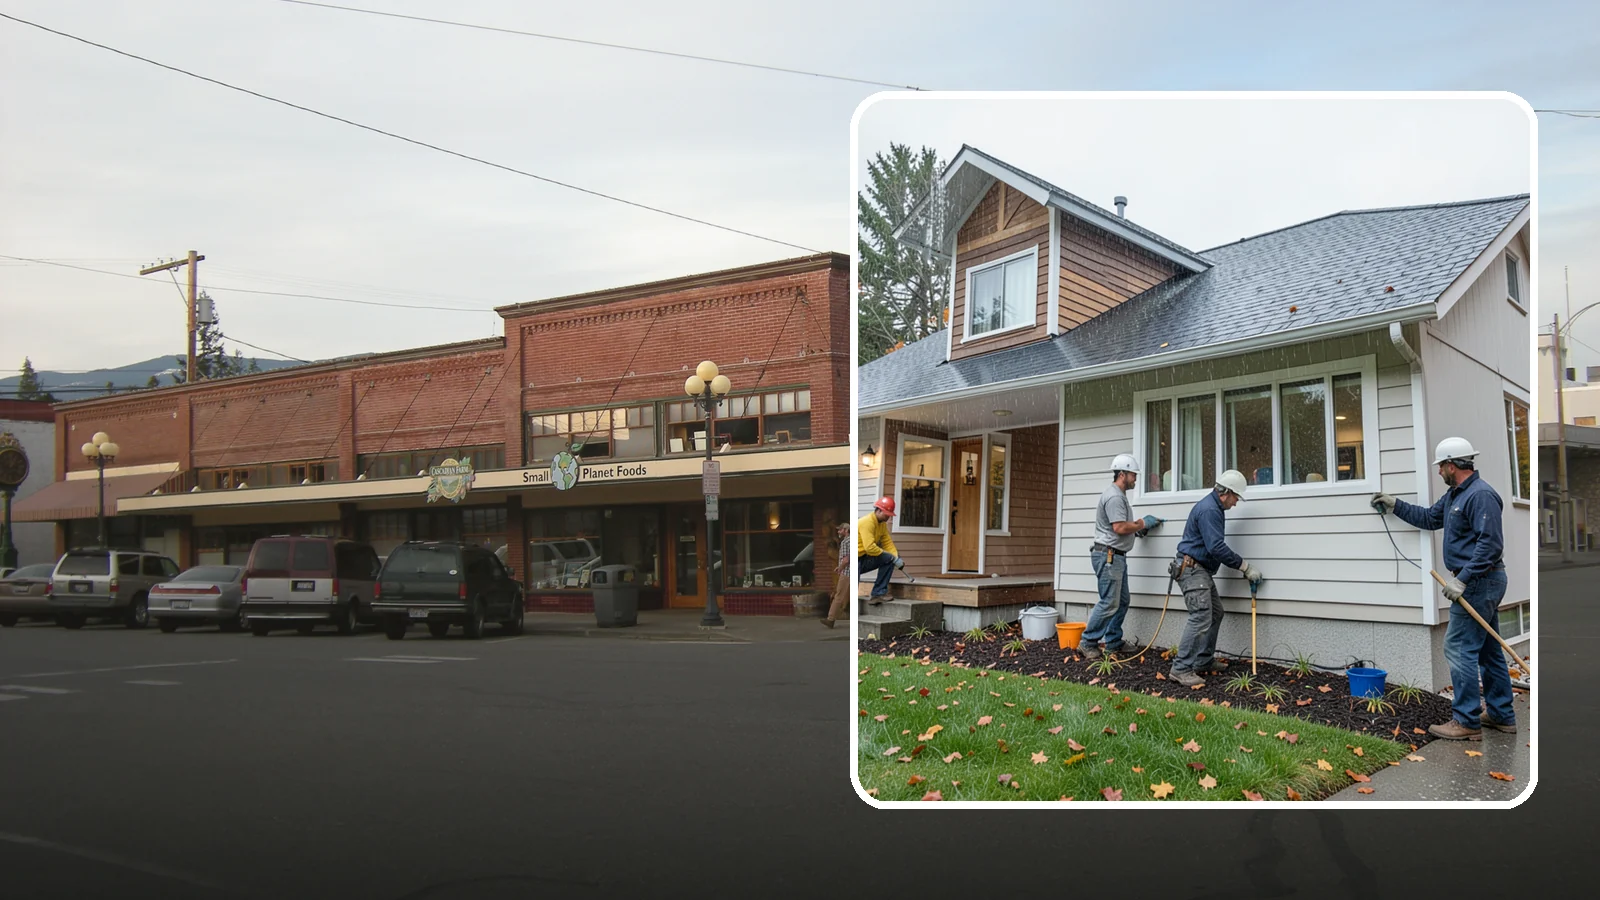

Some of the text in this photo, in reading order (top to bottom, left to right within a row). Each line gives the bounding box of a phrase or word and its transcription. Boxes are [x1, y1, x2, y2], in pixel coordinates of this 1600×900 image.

[523, 464, 647, 483] Small Planet Foods
